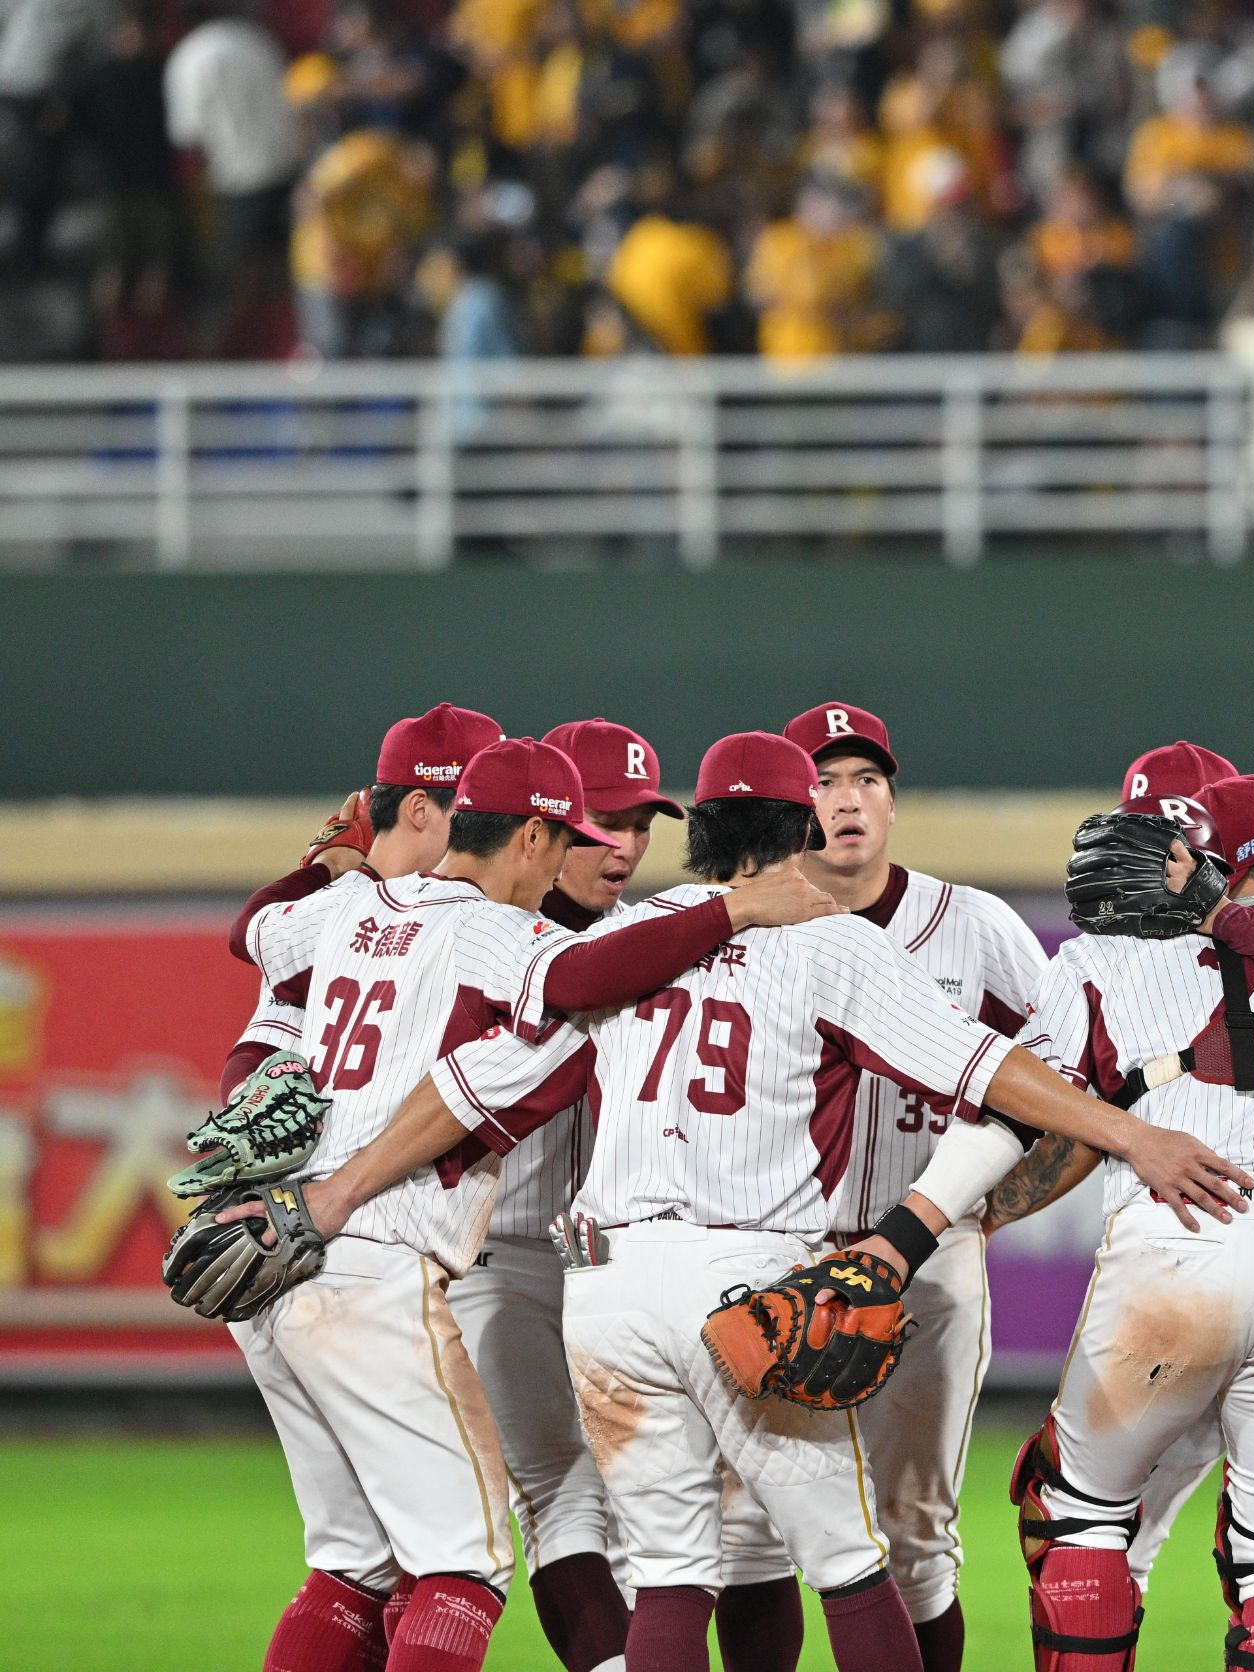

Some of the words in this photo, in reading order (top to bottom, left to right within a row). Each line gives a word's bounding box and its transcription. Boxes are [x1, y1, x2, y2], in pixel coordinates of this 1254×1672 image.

[825, 708, 855, 738] R
[413, 760, 463, 781] tigerair
[624, 742, 650, 779] R
[1130, 773, 1149, 800] R
[530, 792, 572, 812] tigerair
[1159, 799, 1202, 829] R
[309, 975, 397, 1092] 36
[634, 986, 753, 1116] 79
